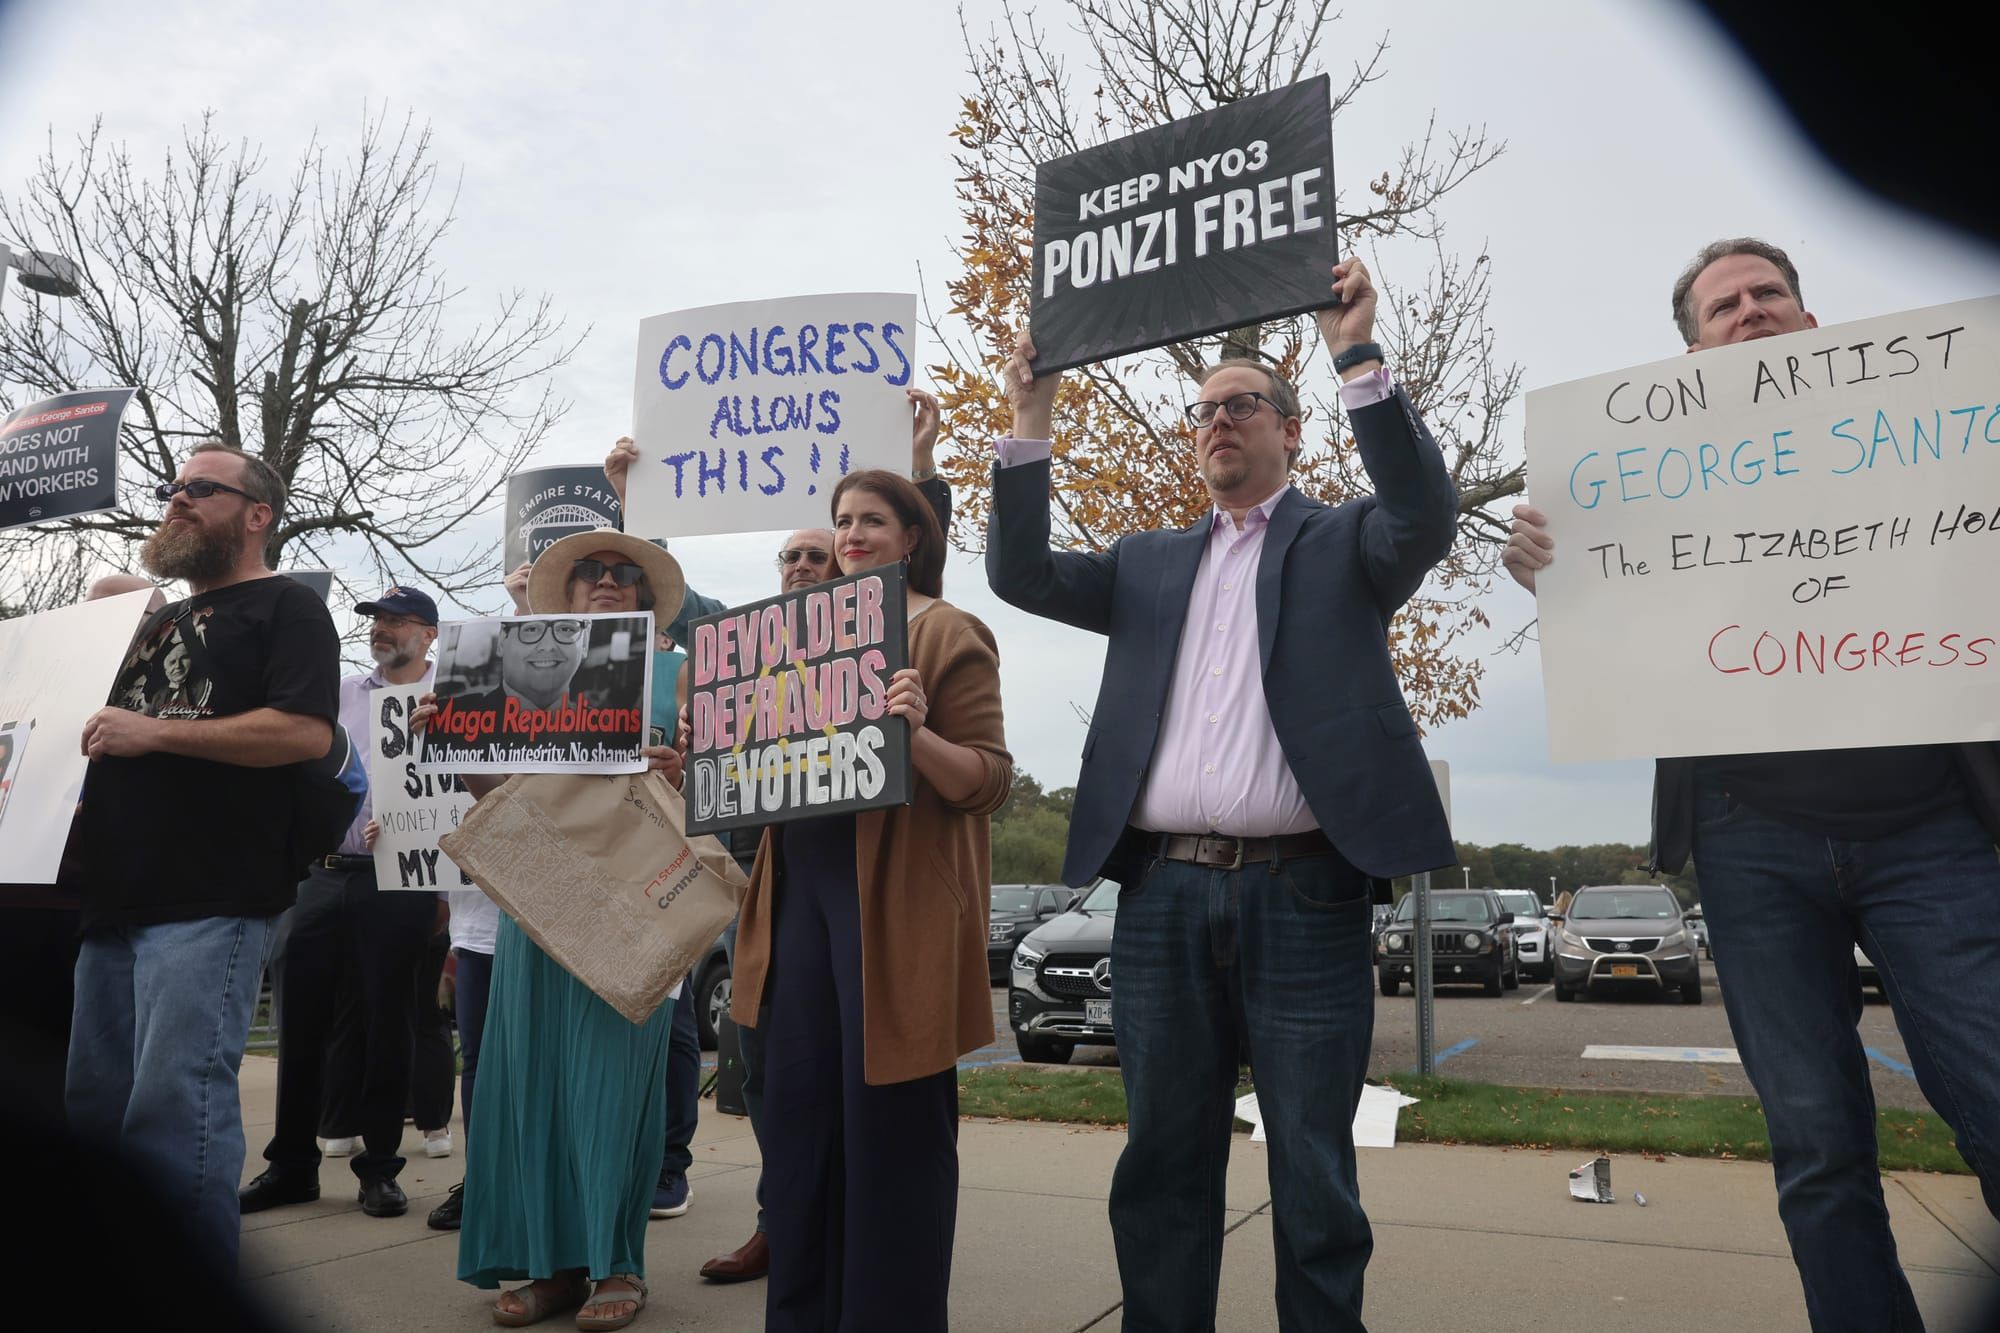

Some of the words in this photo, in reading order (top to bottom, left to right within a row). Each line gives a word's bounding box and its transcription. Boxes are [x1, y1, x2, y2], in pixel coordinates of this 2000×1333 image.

[1079, 172, 1161, 221] KEEP
[1043, 207, 1177, 299] PONZI
[1193, 167, 1322, 257] FREE
[658, 321, 912, 391] CONGRESS
[1605, 368, 1708, 424] CON
[1753, 326, 1965, 404] ARTIST
[41, 409, 72, 423] George
[74, 403, 105, 416] Santos
[44, 425, 84, 448] NOT
[709, 389, 841, 438] ALLOWS
[42, 445, 89, 471] WITH
[1570, 430, 1801, 509] GEORGE
[15, 467, 98, 499] YORKERS
[519, 485, 566, 518] EMPIRE
[573, 485, 620, 512] STATE
[1587, 541, 1651, 580] The
[1671, 516, 1910, 571] ELIZABETH
[1792, 575, 1851, 604] OF
[694, 575, 885, 687] DEVOLDER
[1707, 624, 1996, 676] CONGRESS
[428, 697, 497, 743] Maga
[501, 692, 641, 742] Republicans
[693, 649, 887, 753] DEFRAUDS
[426, 743, 443, 763] No
[444, 743, 485, 763] honor.
[488, 742, 507, 763] No
[508, 742, 565, 763] integrity.
[569, 741, 589, 763] No
[590, 743, 640, 763] shame!
[694, 725, 886, 822] DEVOTERS
[381, 807, 438, 835] MONEY
[397, 847, 440, 888] MY
